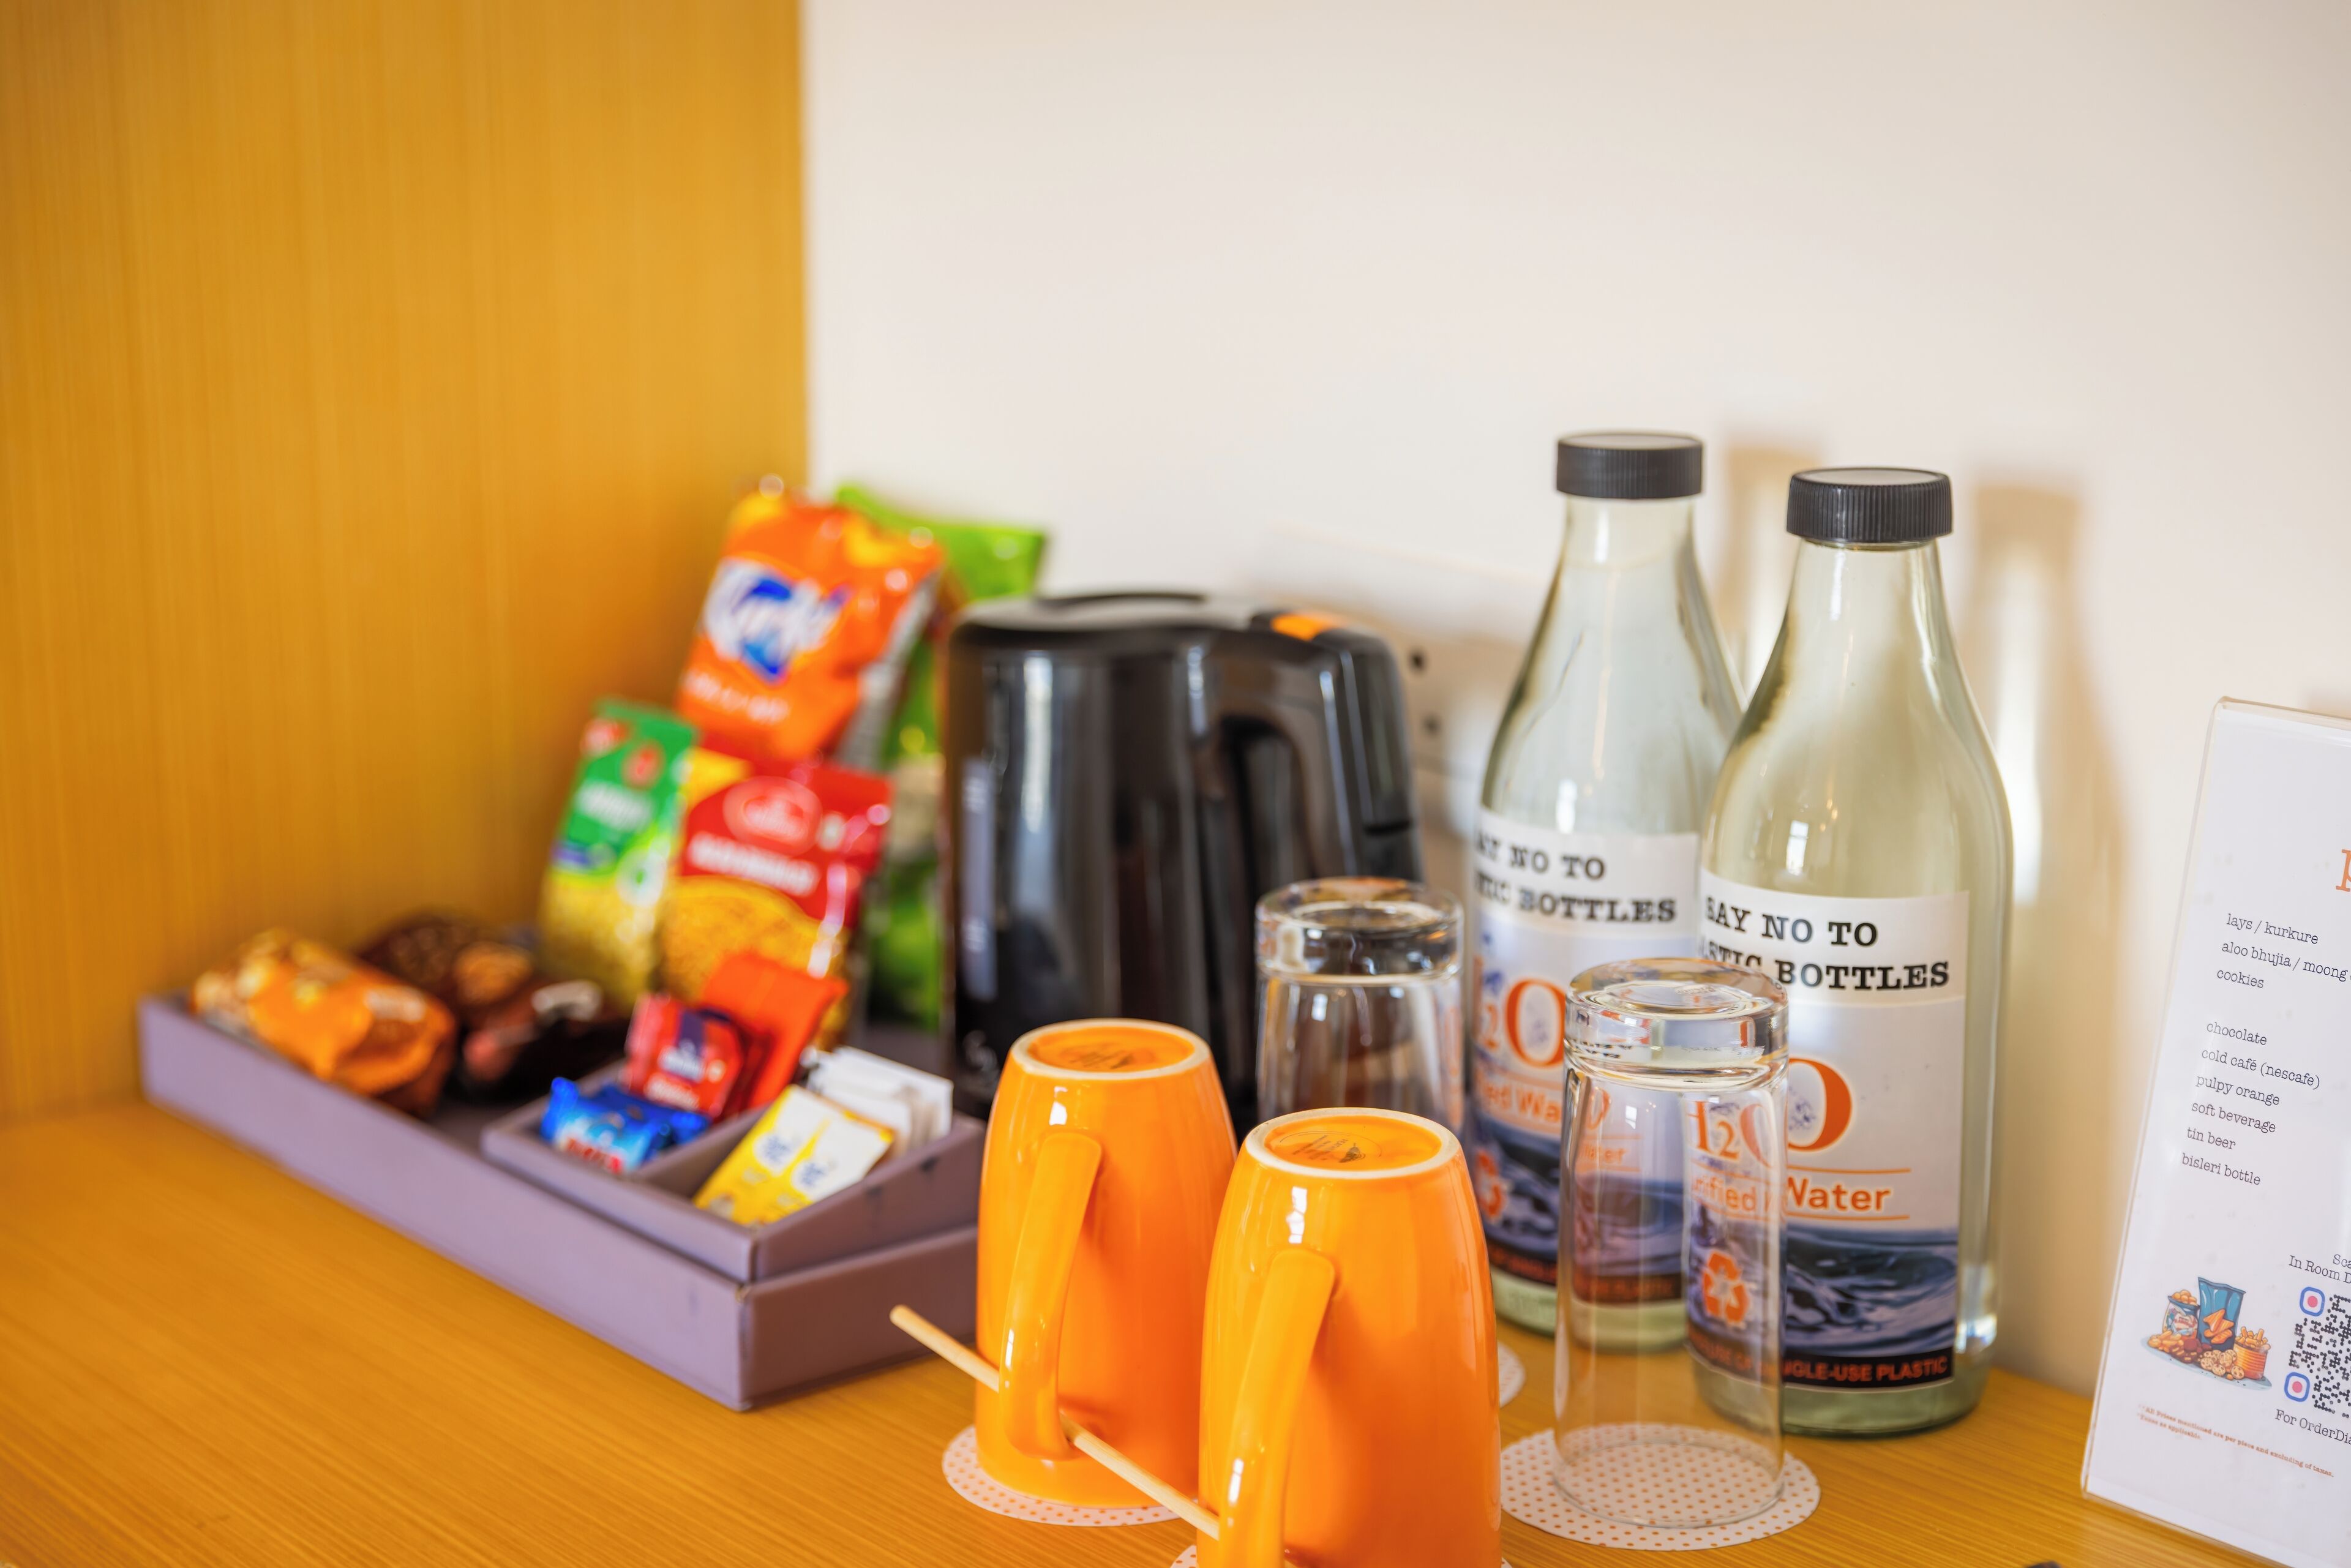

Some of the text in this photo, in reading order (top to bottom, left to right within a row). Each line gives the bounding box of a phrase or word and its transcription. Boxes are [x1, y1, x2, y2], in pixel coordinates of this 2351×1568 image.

[1510, 845, 1550, 874] NO
[1563, 855, 1607, 880] TO
[1520, 887, 1677, 922] BOTTLES
[1706, 897, 1878, 947] SAY NO TO
[2226, 913, 2253, 930] lays
[2264, 921, 2319, 944] kurkure
[1775, 960, 1949, 991] BOTTLES
[2221, 942, 2248, 956] aloo
[2251, 947, 2292, 966] bhujia
[2303, 961, 2349, 982] moong
[2217, 969, 2264, 988] cookies
[2207, 1022, 2267, 1045] chocolate
[2202, 1050, 2320, 1090] cold café (nescafe)
[2195, 1076, 2280, 1106] pulpy orange
[2191, 1103, 2276, 1133] soft beverage
[2187, 1127, 2236, 1150] tin beer
[2182, 1152, 2260, 1185] bisleri bottle
[2289, 1255, 2302, 1269] In
[2304, 1259, 2341, 1281] Room
[1876, 1356, 1948, 1381] PLASTIC
[2275, 1408, 2297, 1425] For
[2256, 1446, 2268, 1454] and
[2270, 1451, 2303, 1468] excluding
